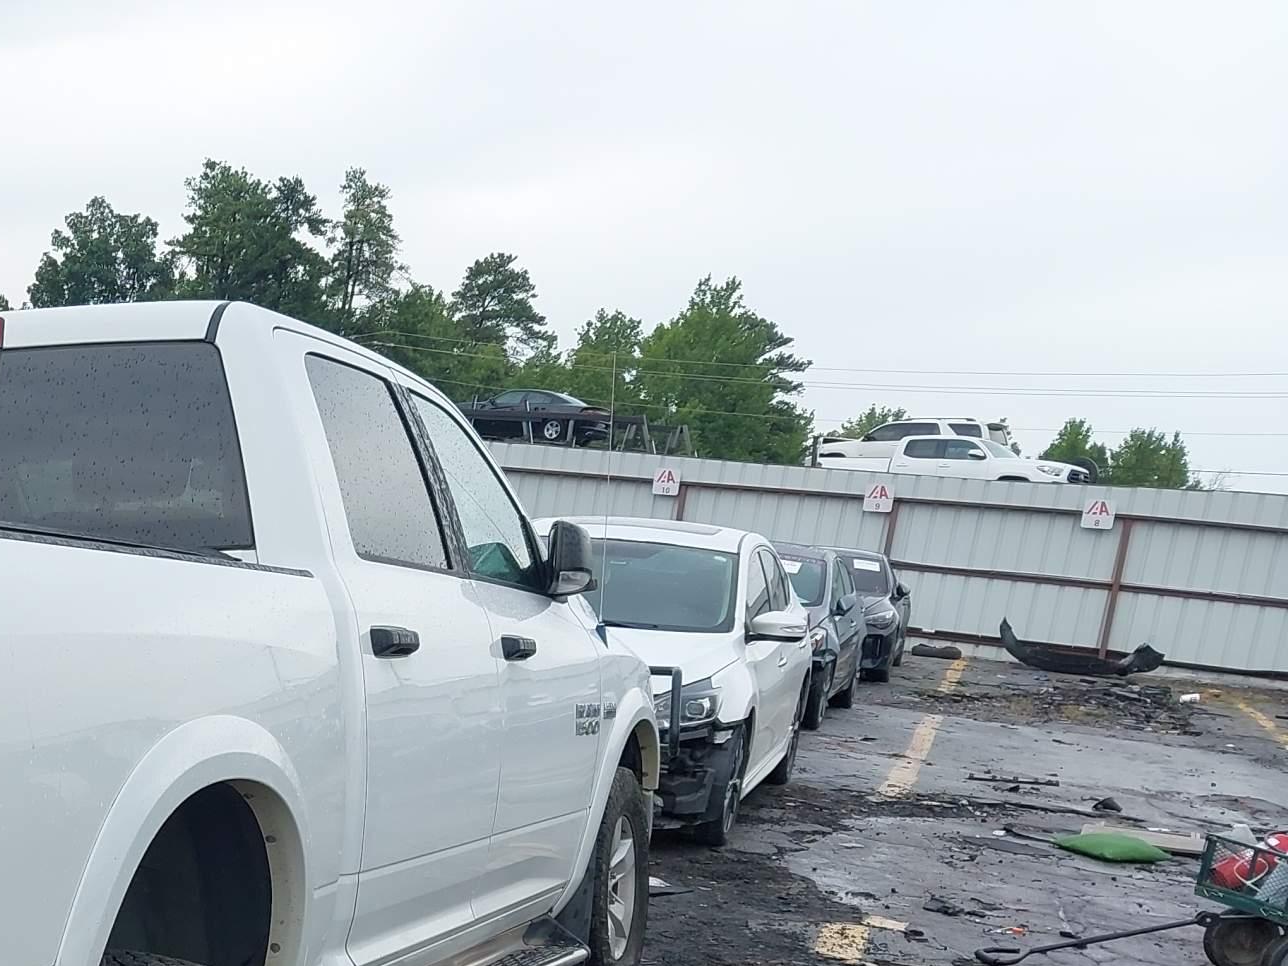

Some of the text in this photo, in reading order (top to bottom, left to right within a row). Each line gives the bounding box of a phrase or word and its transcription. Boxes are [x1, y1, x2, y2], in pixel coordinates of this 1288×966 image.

[662, 486, 671, 494] 10
[875, 502, 881, 510] 9
[1094, 519, 1101, 527] 8
